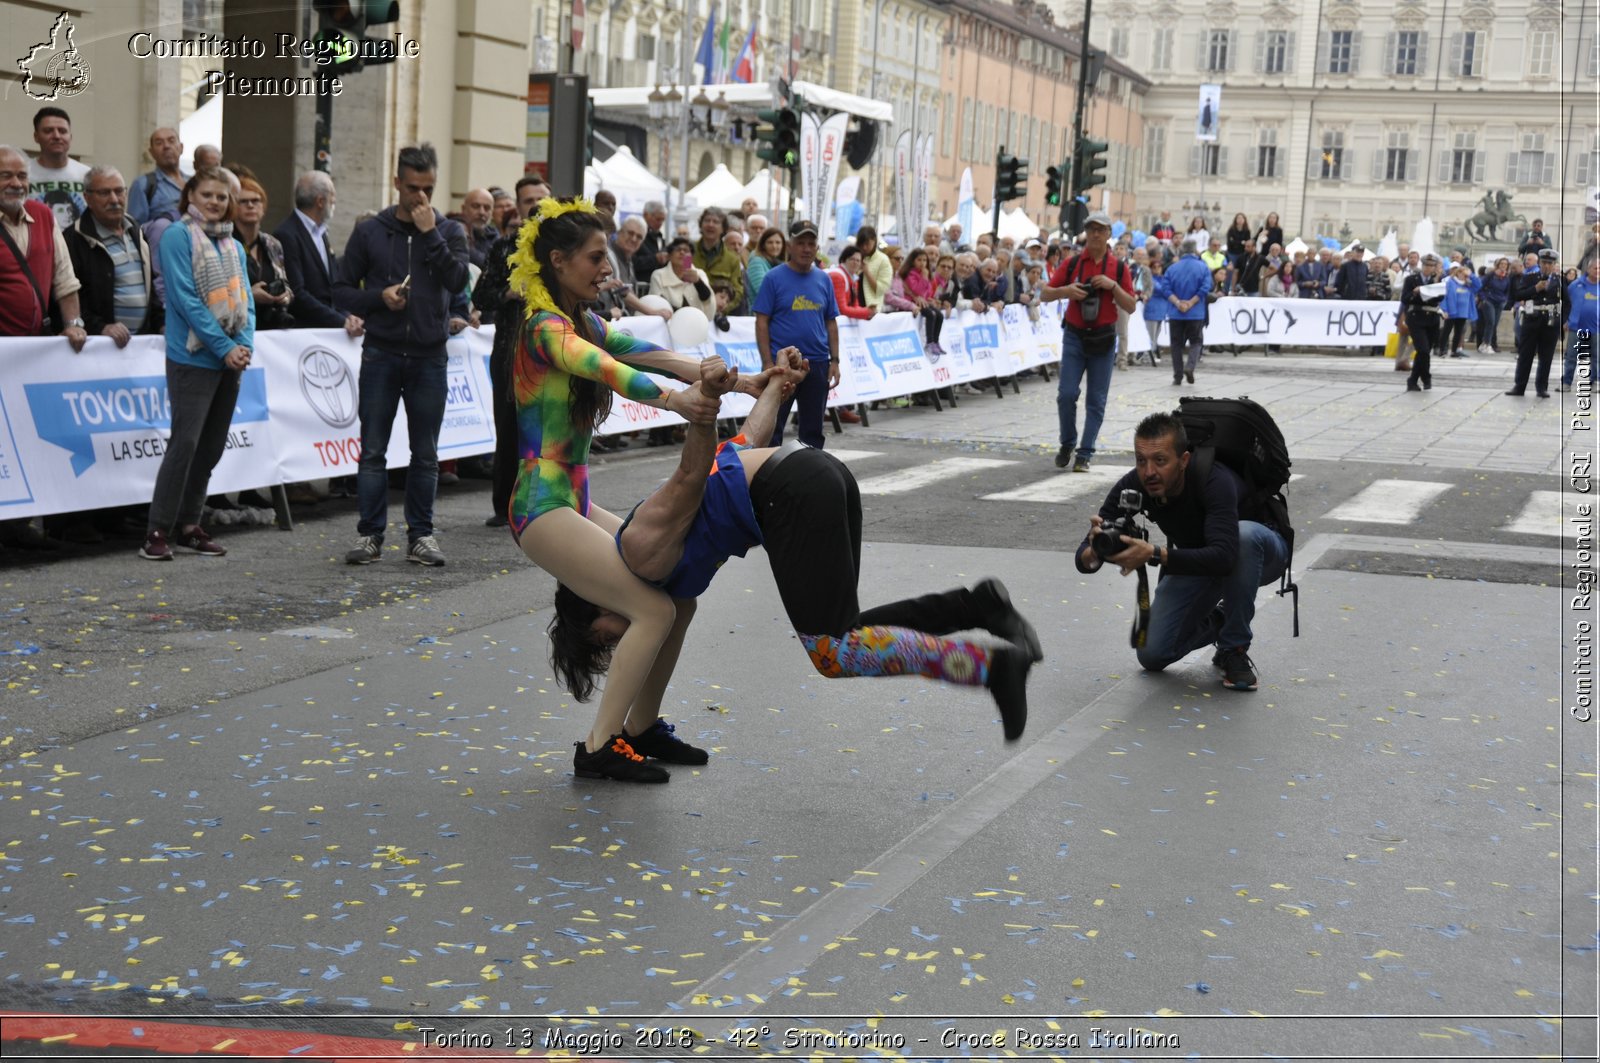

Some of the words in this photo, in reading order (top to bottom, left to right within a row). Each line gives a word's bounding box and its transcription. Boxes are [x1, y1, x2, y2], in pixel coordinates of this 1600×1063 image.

[1327, 310, 1384, 336] HOLY
[62, 387, 164, 426] TOYOTA
[622, 403, 661, 422] TOYOTA
[111, 440, 131, 461] LA
[313, 437, 362, 467] TOYO
